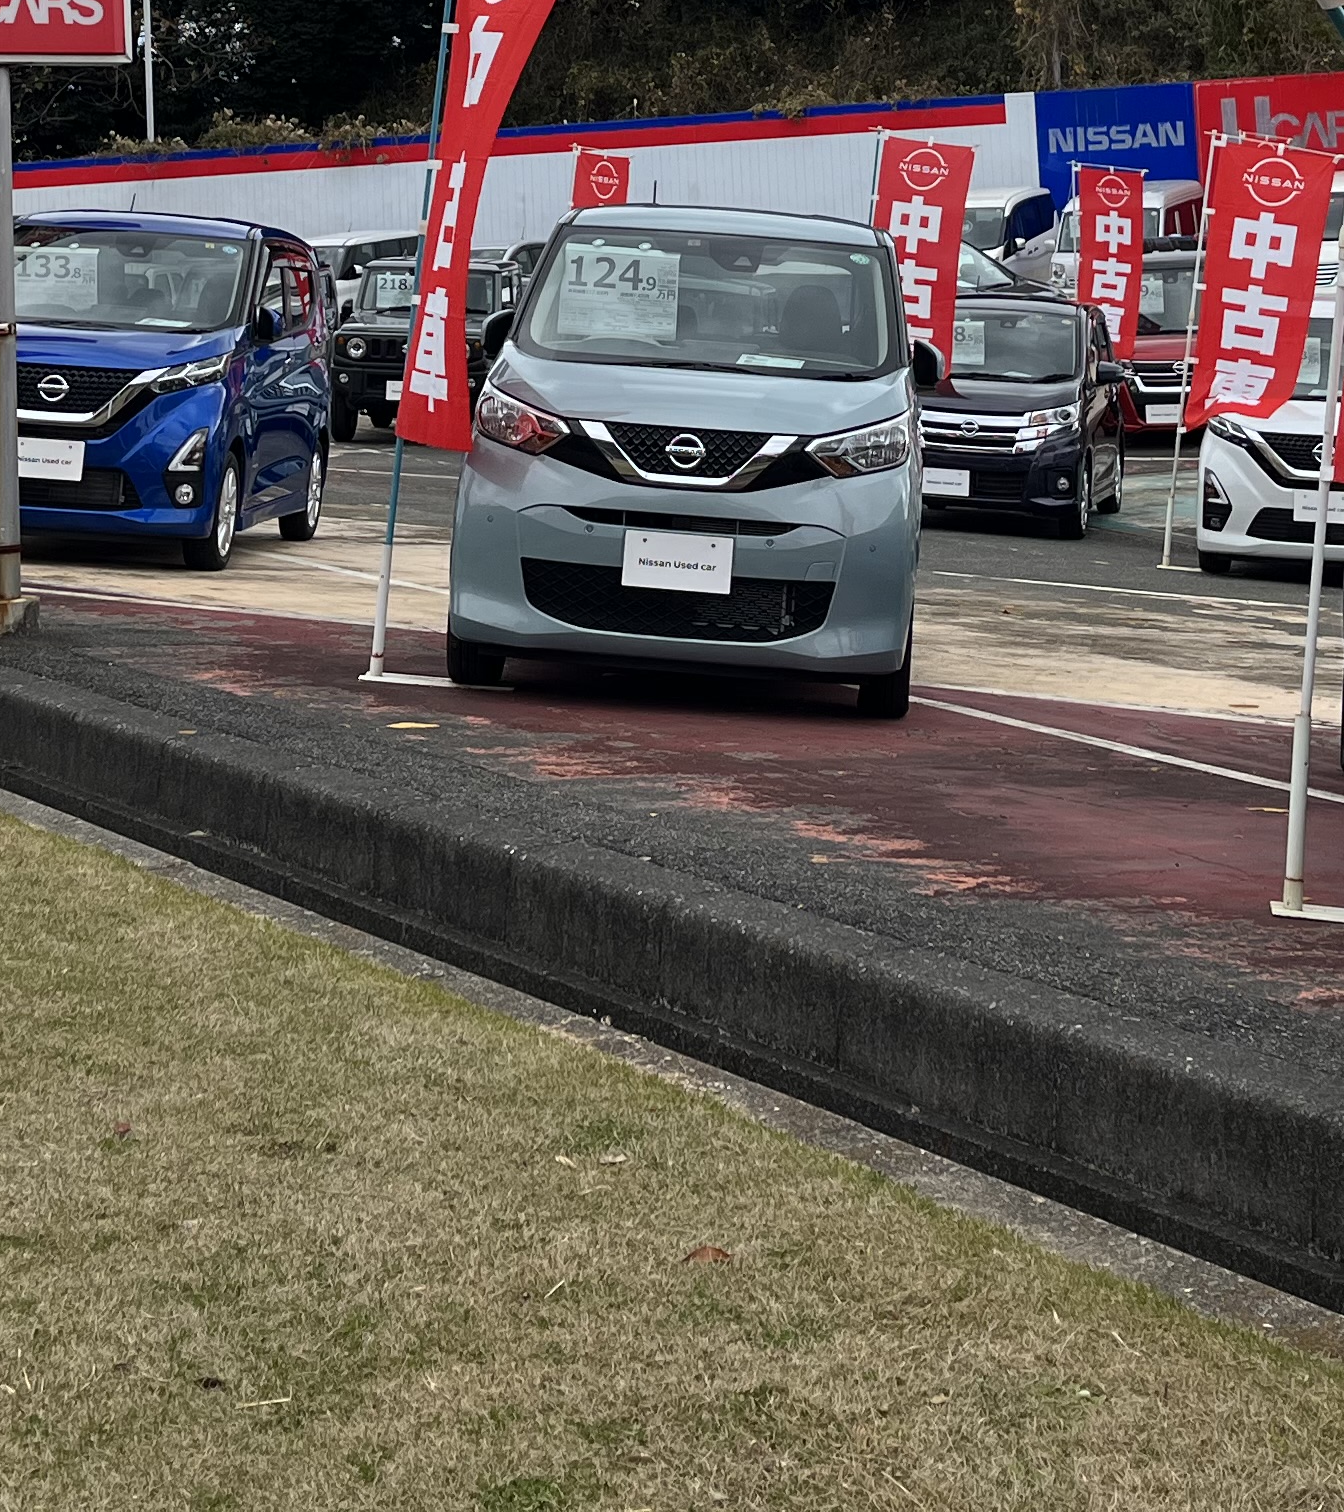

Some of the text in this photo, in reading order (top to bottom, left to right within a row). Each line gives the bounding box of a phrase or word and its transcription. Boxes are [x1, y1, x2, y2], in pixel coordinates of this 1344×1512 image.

[1048, 120, 1185, 155] NISSAN
[898, 161, 950, 177] NISSAN
[1242, 171, 1305, 191] NISSAN
[1096, 186, 1131, 197] NISSAN
[16, 254, 82, 279] 133.8
[567, 255, 657, 292] 124.9
[656, 288, 676, 301] 万円
[1204, 210, 1299, 411] 中古車
[41, 457, 60, 465] Used
[638, 557, 717, 572] Nissan Used car
